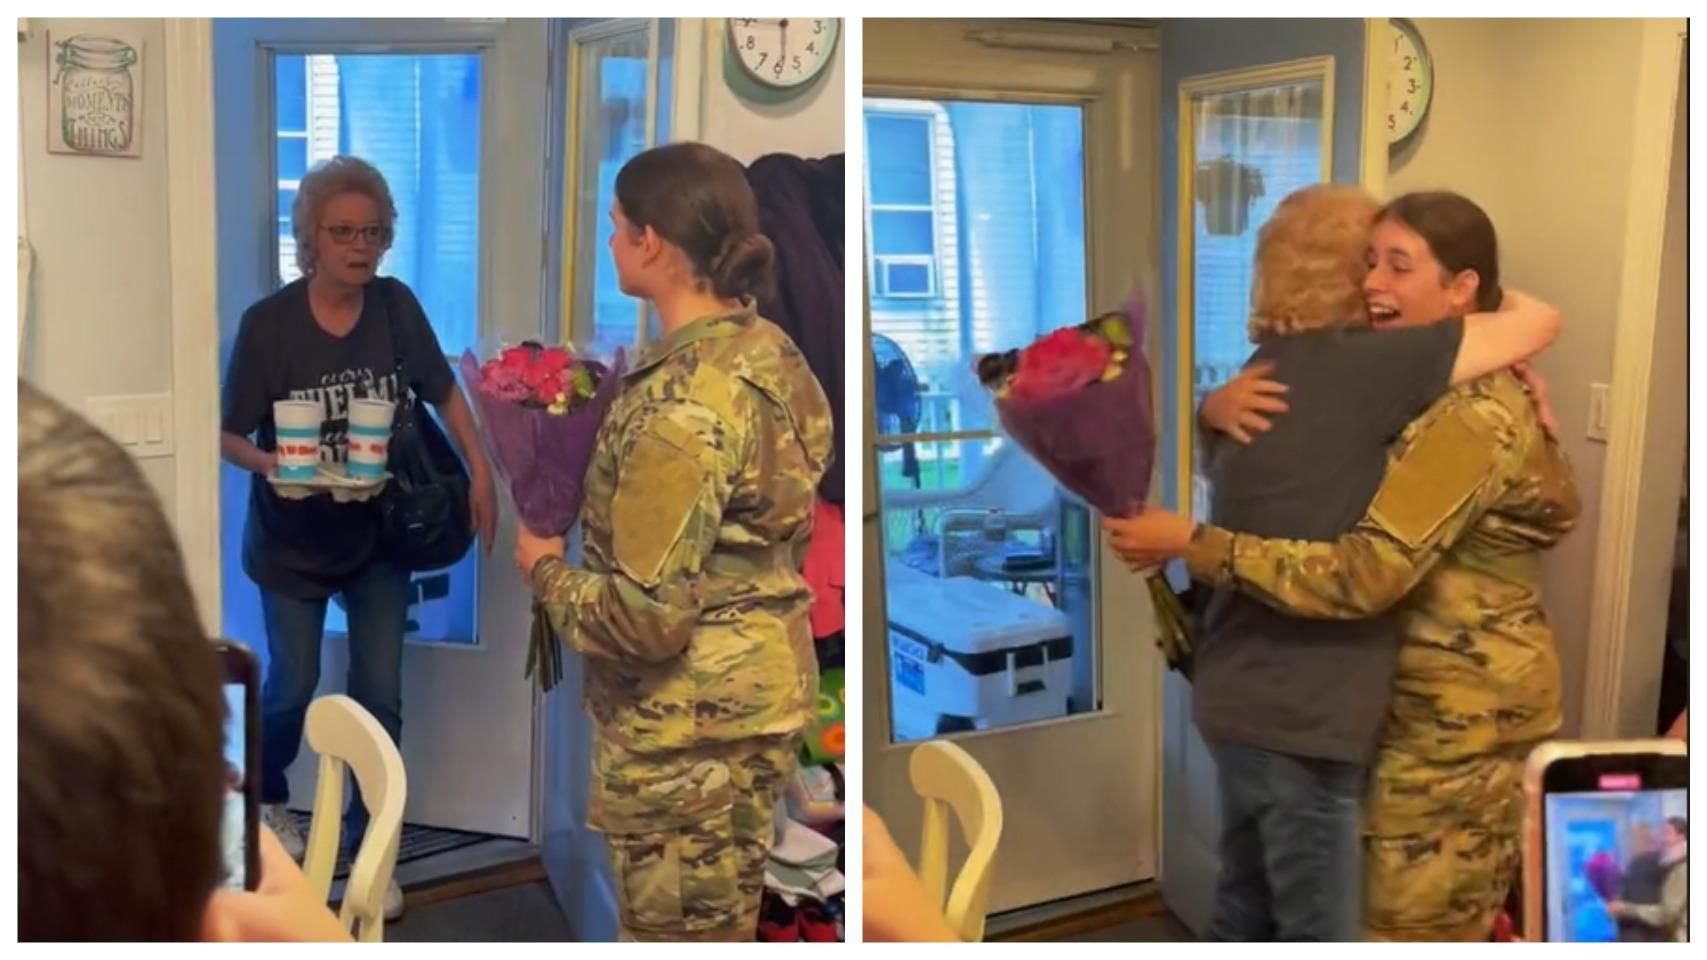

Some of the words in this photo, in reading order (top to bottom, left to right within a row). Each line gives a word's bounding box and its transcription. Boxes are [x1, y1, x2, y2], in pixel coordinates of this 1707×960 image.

[813, 20, 822, 34] 3
[746, 35, 755, 50] 8
[805, 41, 815, 54] 4
[759, 52, 769, 66] 7
[792, 56, 802, 70] 5
[1403, 56, 1412, 70] 2
[773, 60, 783, 74] 6
[1407, 78, 1416, 93] 3
[1400, 101, 1409, 112] 4
[1388, 114, 1396, 130] 5
[66, 117, 129, 150] THINGS
